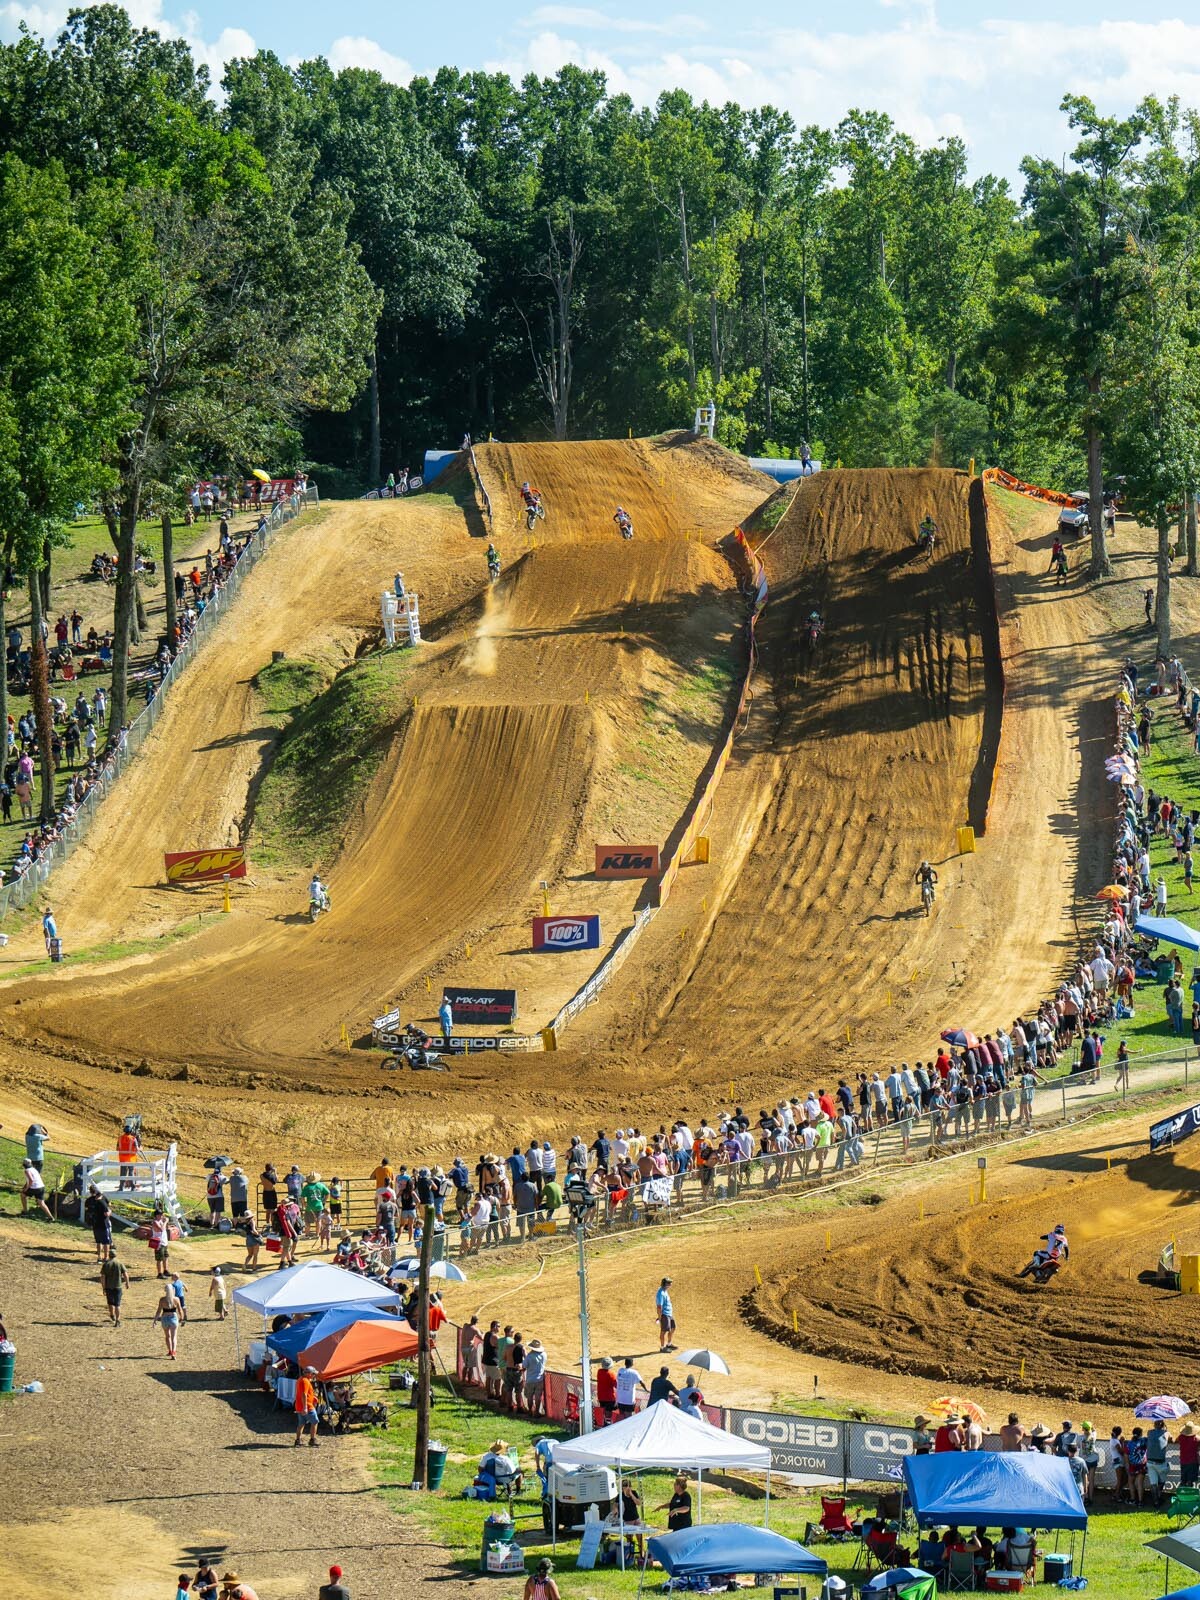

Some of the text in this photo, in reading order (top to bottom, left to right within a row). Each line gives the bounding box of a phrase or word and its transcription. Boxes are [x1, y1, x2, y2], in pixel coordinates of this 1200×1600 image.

[168, 850, 244, 879] FMF
[601, 853, 653, 869] KTM
[550, 926, 582, 940] 100%
[450, 1037, 496, 1048] GEICO
[500, 1037, 530, 1048] GEICO
